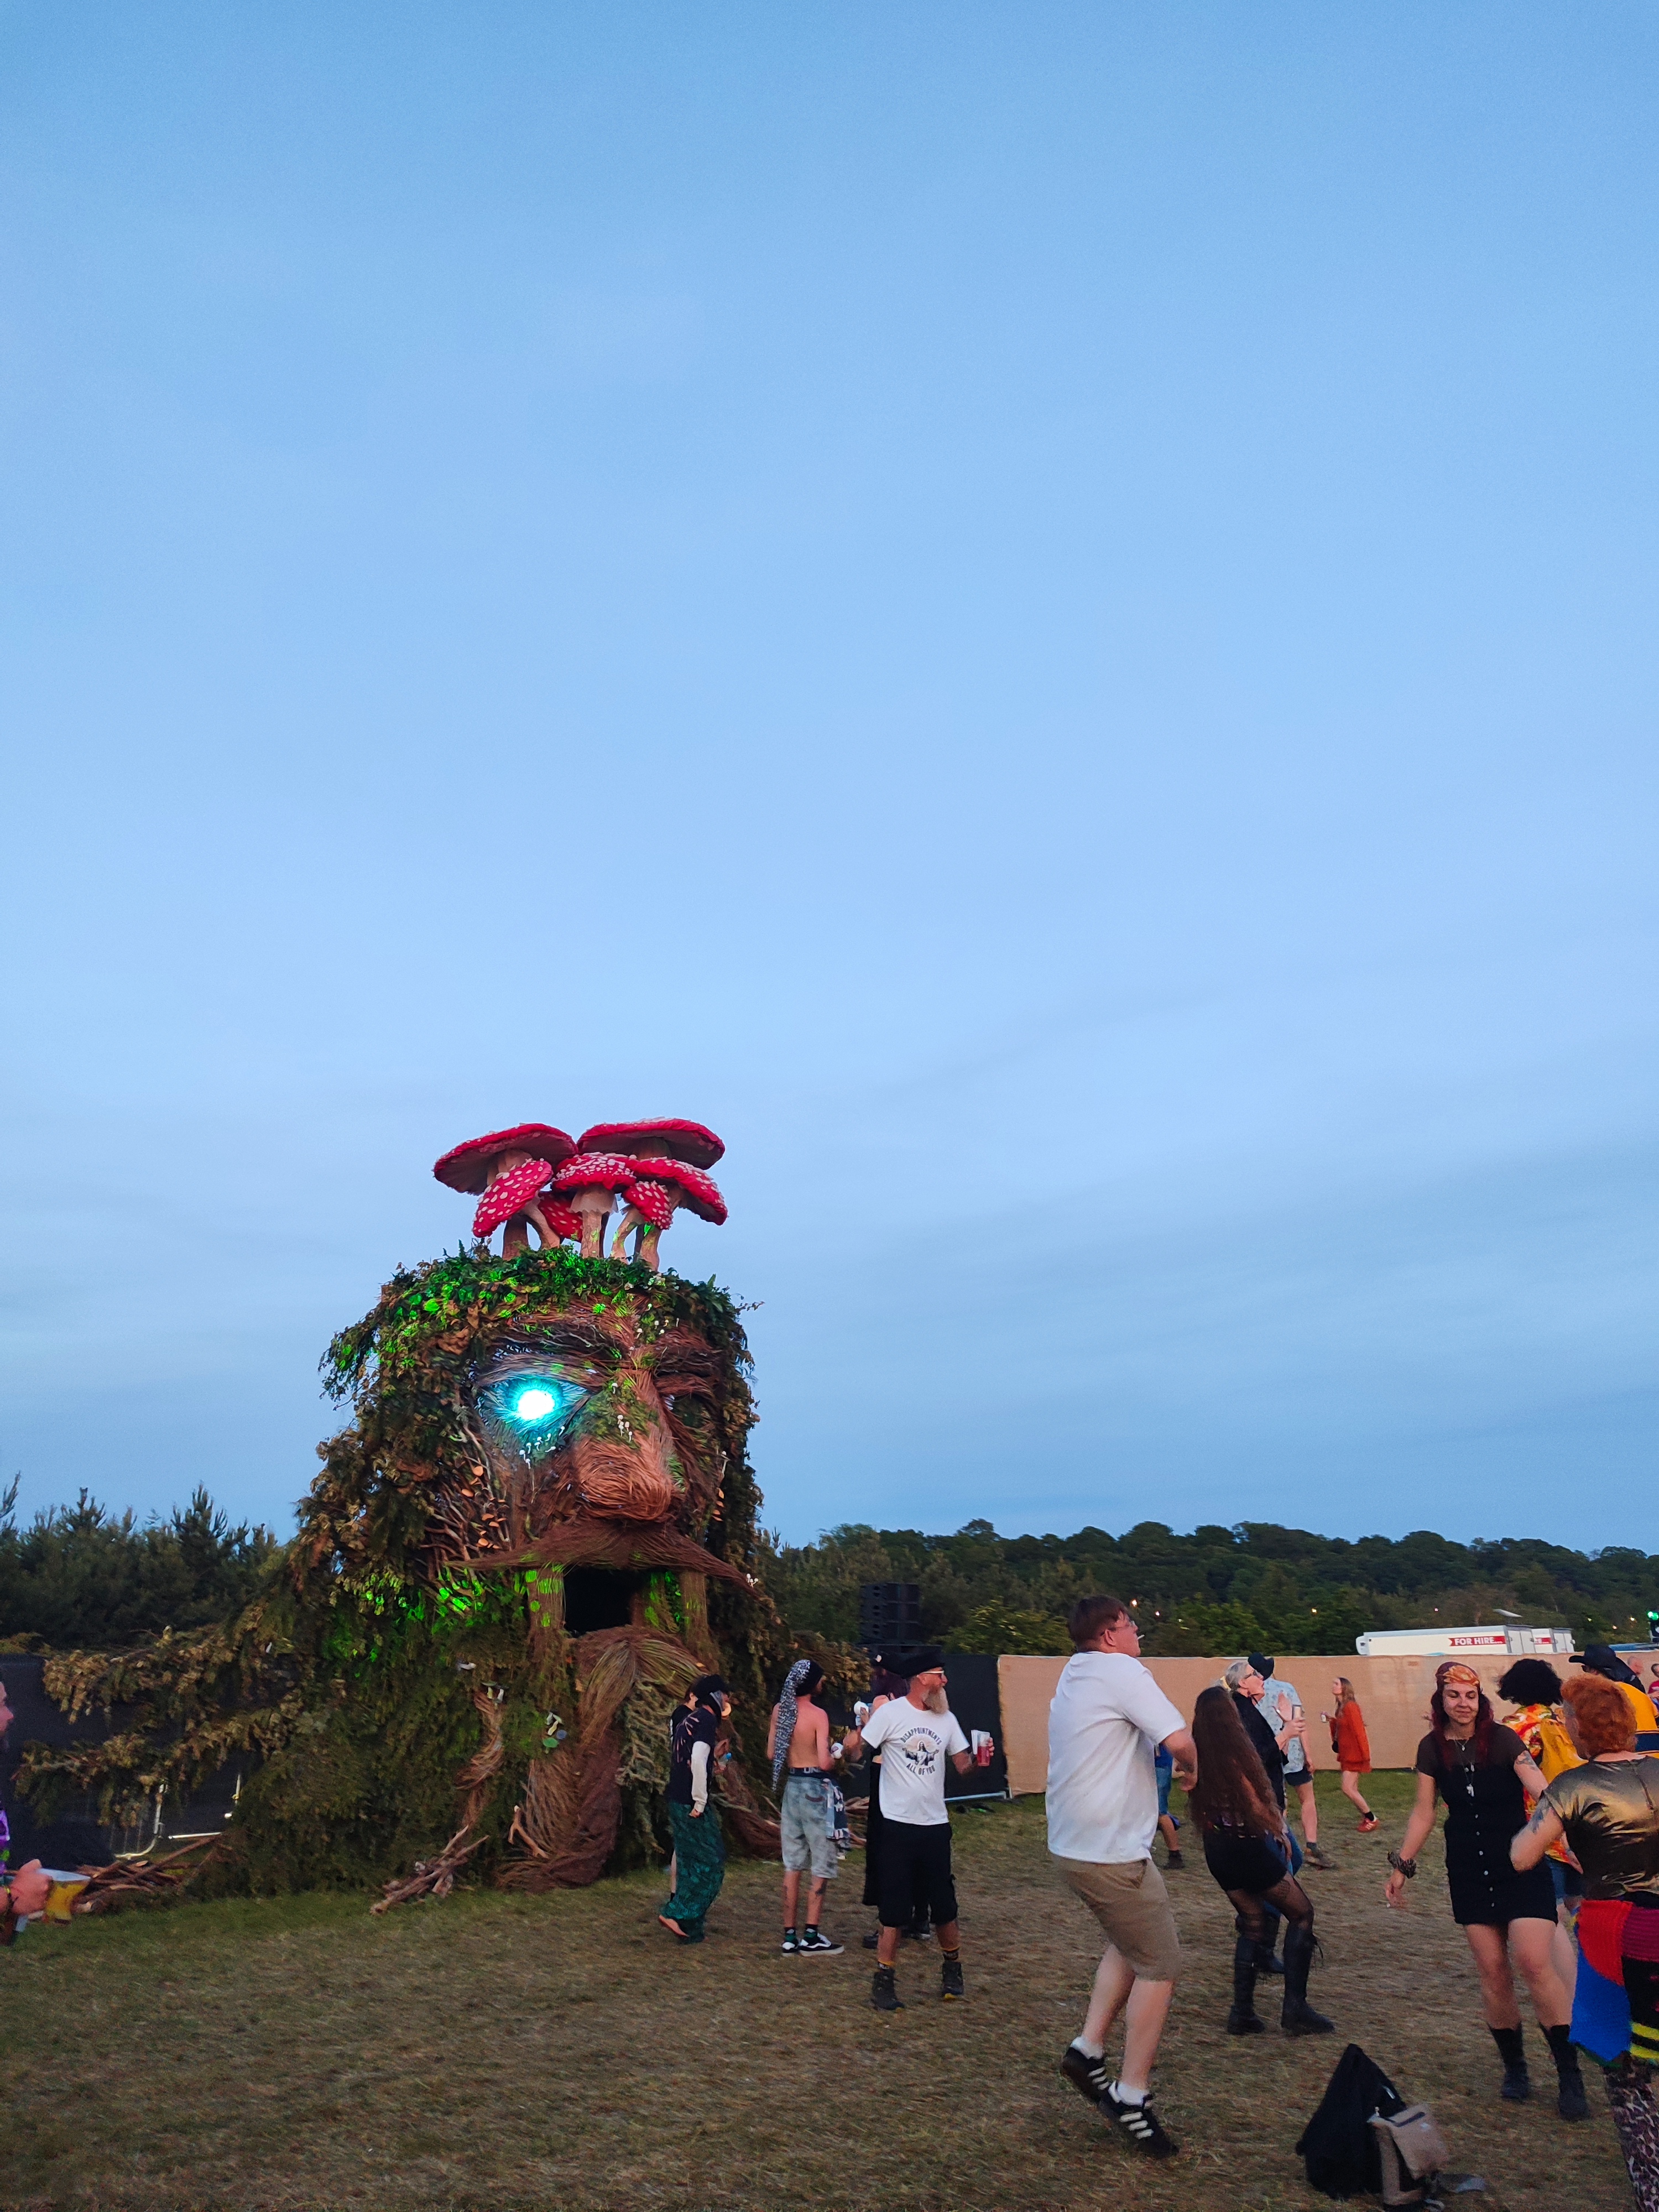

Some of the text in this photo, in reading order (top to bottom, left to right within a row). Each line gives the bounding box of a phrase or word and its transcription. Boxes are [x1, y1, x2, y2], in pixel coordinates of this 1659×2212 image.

[900, 1727, 942, 1745] DISAPPOINTMENTS
[906, 1763, 916, 1773] ALL
[925, 1765, 935, 1775] YOU
